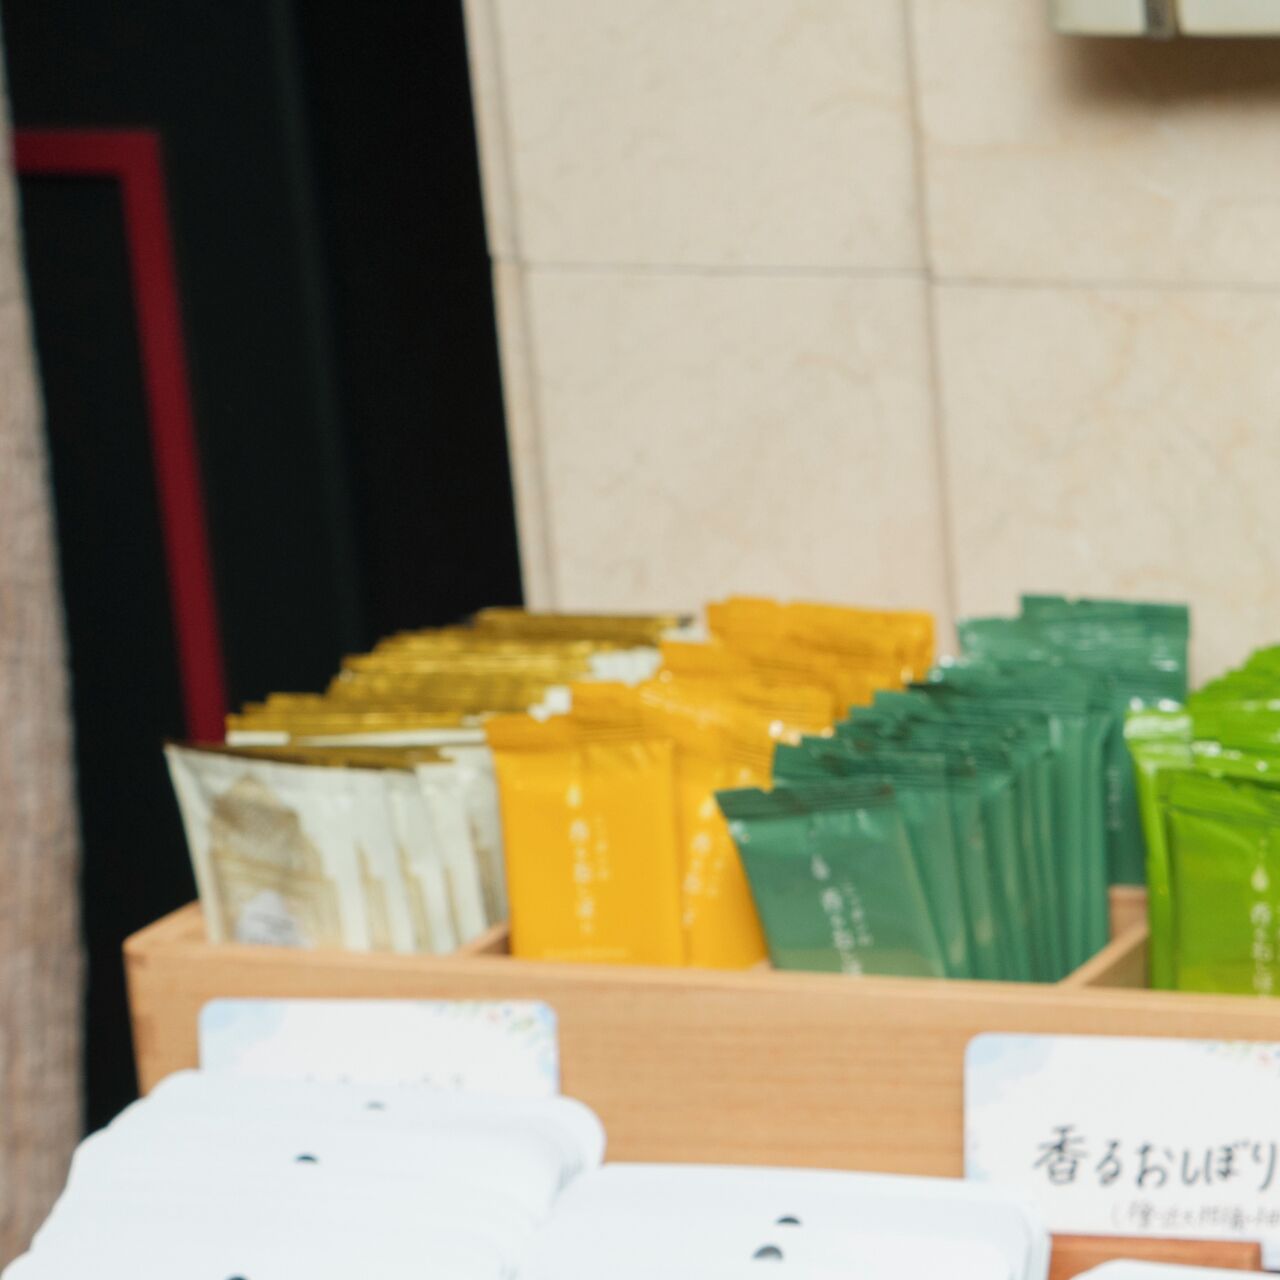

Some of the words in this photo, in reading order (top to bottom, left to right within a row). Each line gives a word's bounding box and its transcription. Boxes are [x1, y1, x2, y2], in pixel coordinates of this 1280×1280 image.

[1033, 1124, 1280, 1191] 香るおしぼり
